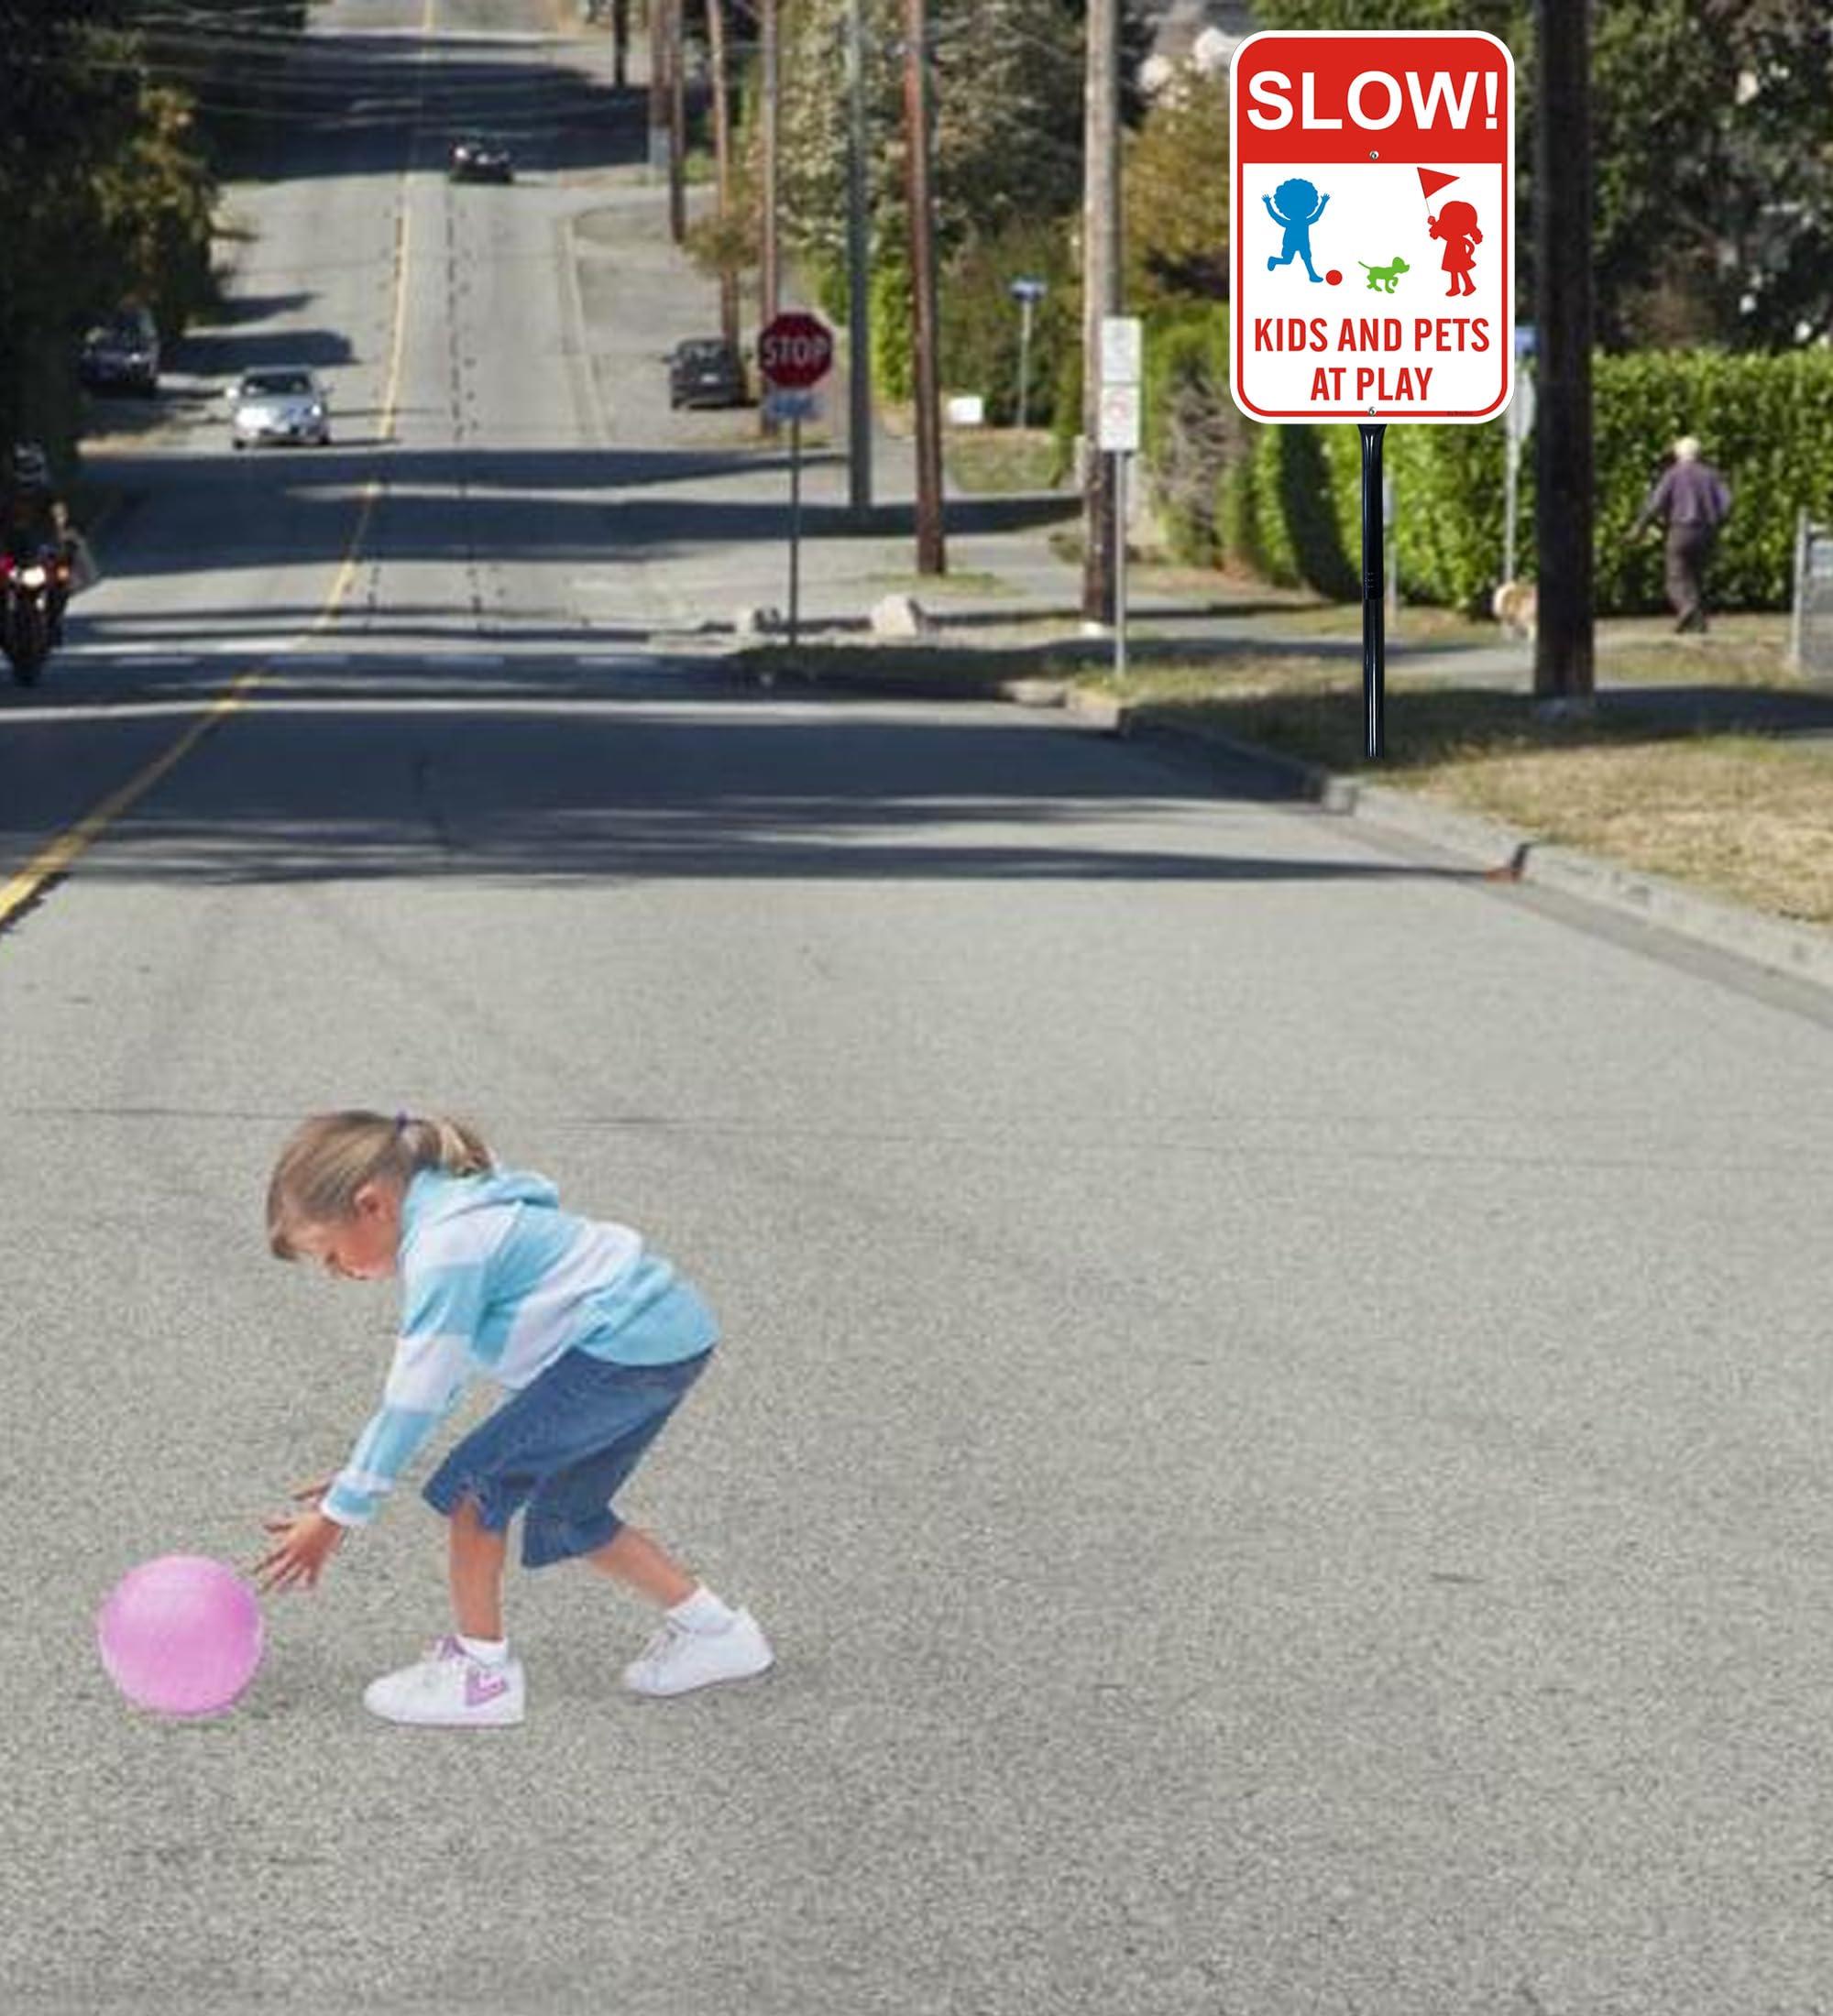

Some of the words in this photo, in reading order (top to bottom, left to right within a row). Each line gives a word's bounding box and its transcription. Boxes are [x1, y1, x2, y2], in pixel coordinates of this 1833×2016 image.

[1247, 71, 1498, 130] SLOW!
[763, 335, 828, 367] STOP
[1255, 318, 1328, 352] KIDS
[1337, 318, 1402, 352] AND
[1414, 318, 1490, 352] PETS
[1310, 367, 1346, 400] AT
[1356, 367, 1433, 400] PLAY
